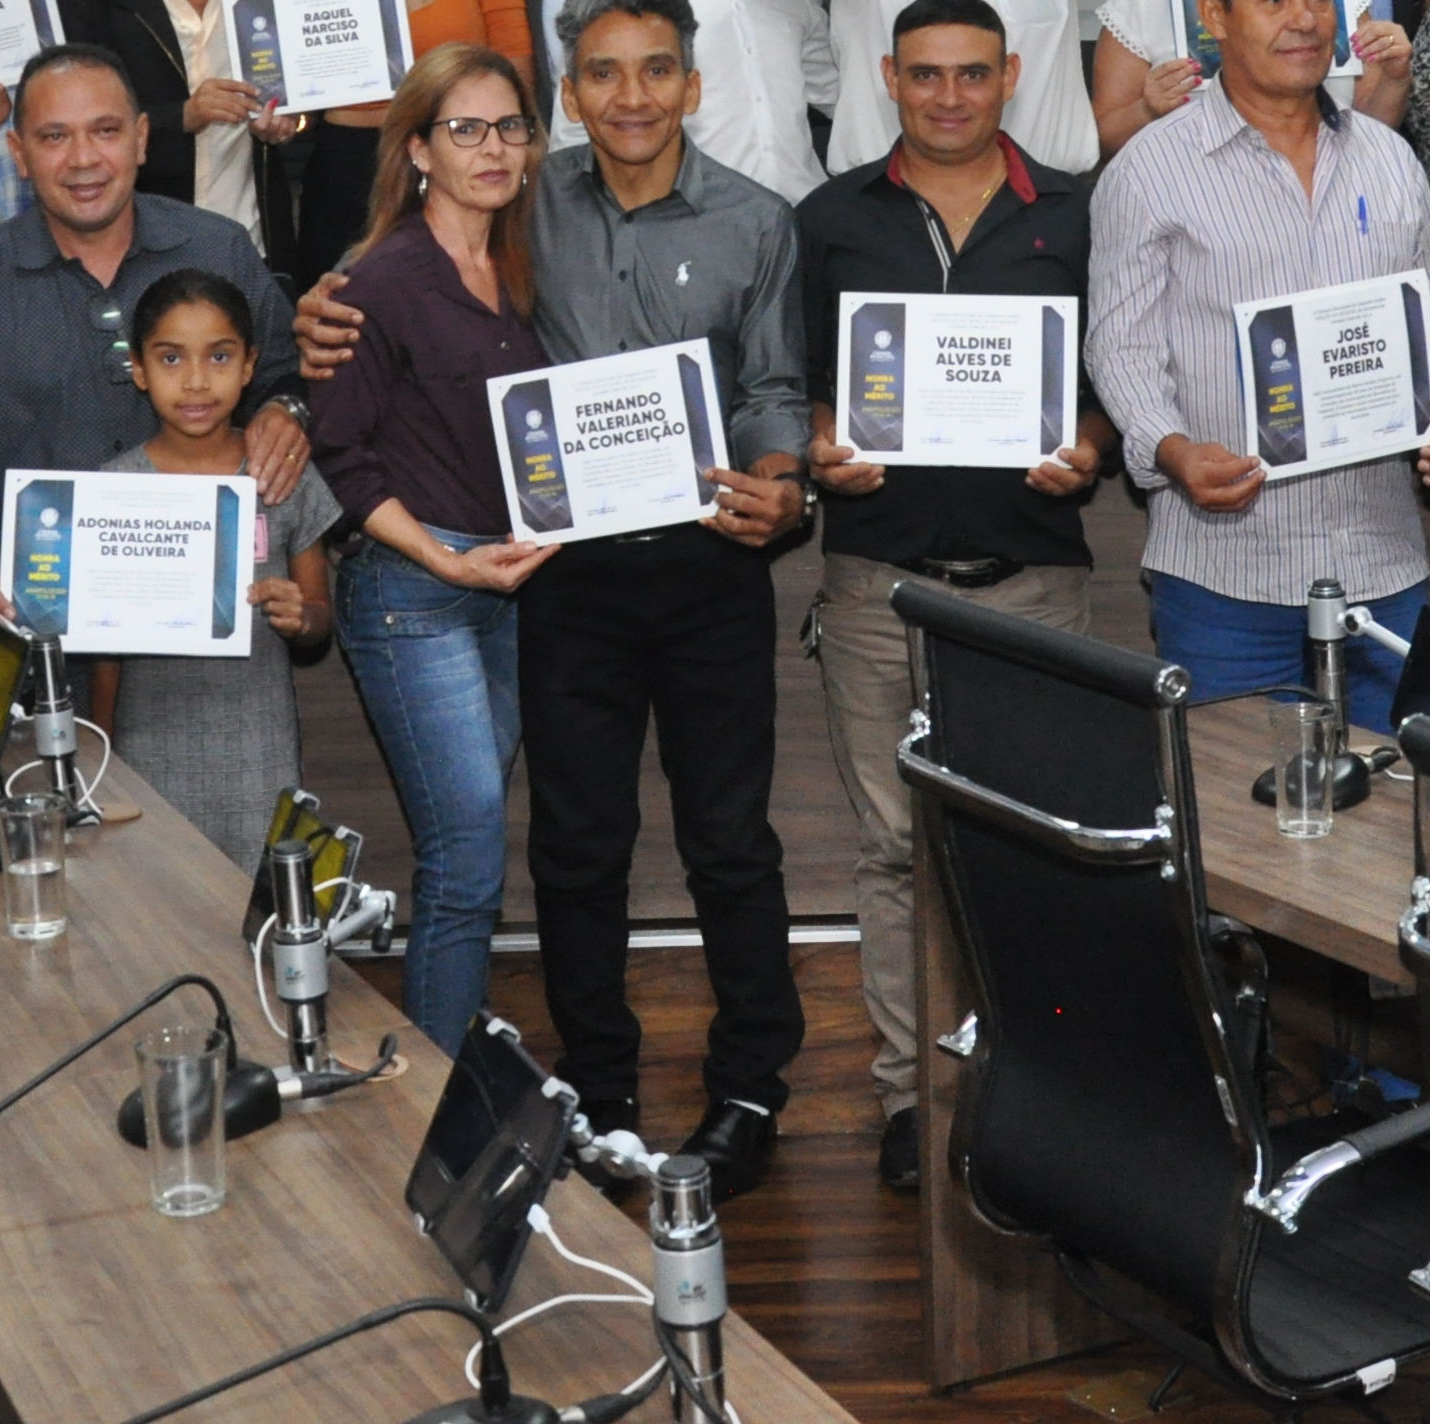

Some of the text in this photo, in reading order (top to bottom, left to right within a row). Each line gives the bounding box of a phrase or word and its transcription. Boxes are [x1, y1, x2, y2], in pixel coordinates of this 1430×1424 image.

[304, 8, 353, 22] RAQUEL
[302, 20, 358, 35] NARCISO
[305, 32, 359, 47] DA SILVA
[1337, 322, 1369, 343] JOSÉ
[937, 337, 1011, 350] VALDINEI
[1323, 339, 1386, 364] EVARISTO
[936, 353, 1011, 366] ALVES DE
[1330, 357, 1383, 378] PEREIRA
[946, 369, 1001, 382] SOUZA
[576, 392, 662, 419] FERNANDO
[576, 408, 666, 435] VALERIANO
[564, 420, 685, 454] DA CONCEIÇÃO
[77, 518, 211, 531] ADONIAS HOLANDA
[99, 532, 188, 544] CAVALCANTE
[101, 545, 185, 557] DE OLIVEIRA
